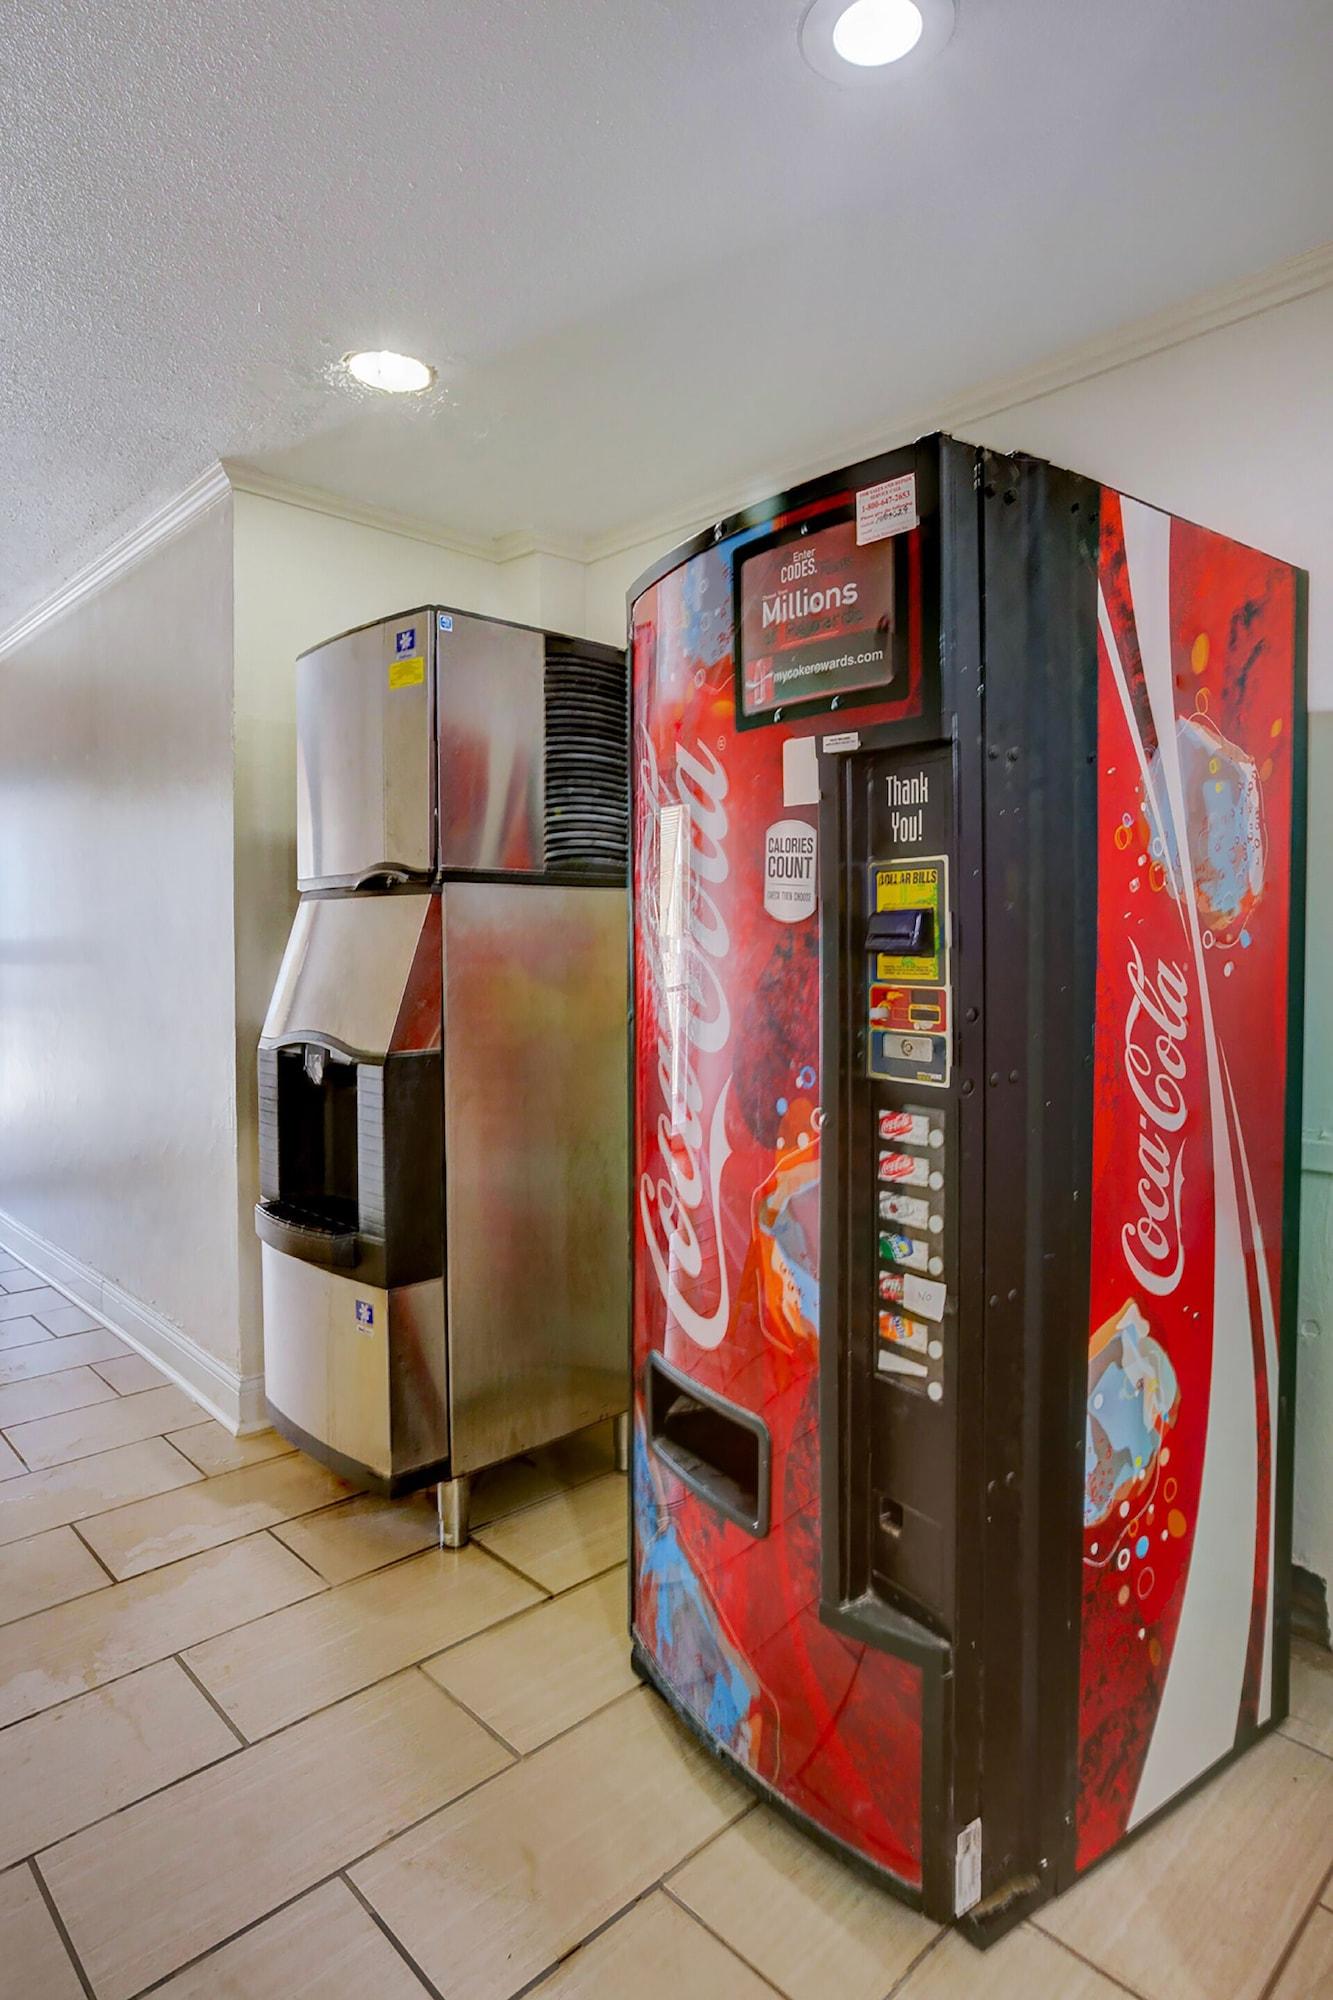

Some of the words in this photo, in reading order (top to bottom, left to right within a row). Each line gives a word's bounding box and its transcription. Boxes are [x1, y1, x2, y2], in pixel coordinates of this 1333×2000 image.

[793, 548, 816, 562] Enter
[780, 558, 818, 583] CODES.
[762, 582, 858, 628] Millions
[773, 650, 883, 684] mycokerewards.com
[885, 771, 929, 807] Thank
[891, 809, 923, 843] You!
[768, 837, 813, 854] CALORIES
[768, 856, 813, 879] COUNT
[912, 870, 937, 884] BILLS
[1121, 936, 1189, 1296] Coca-Cola
